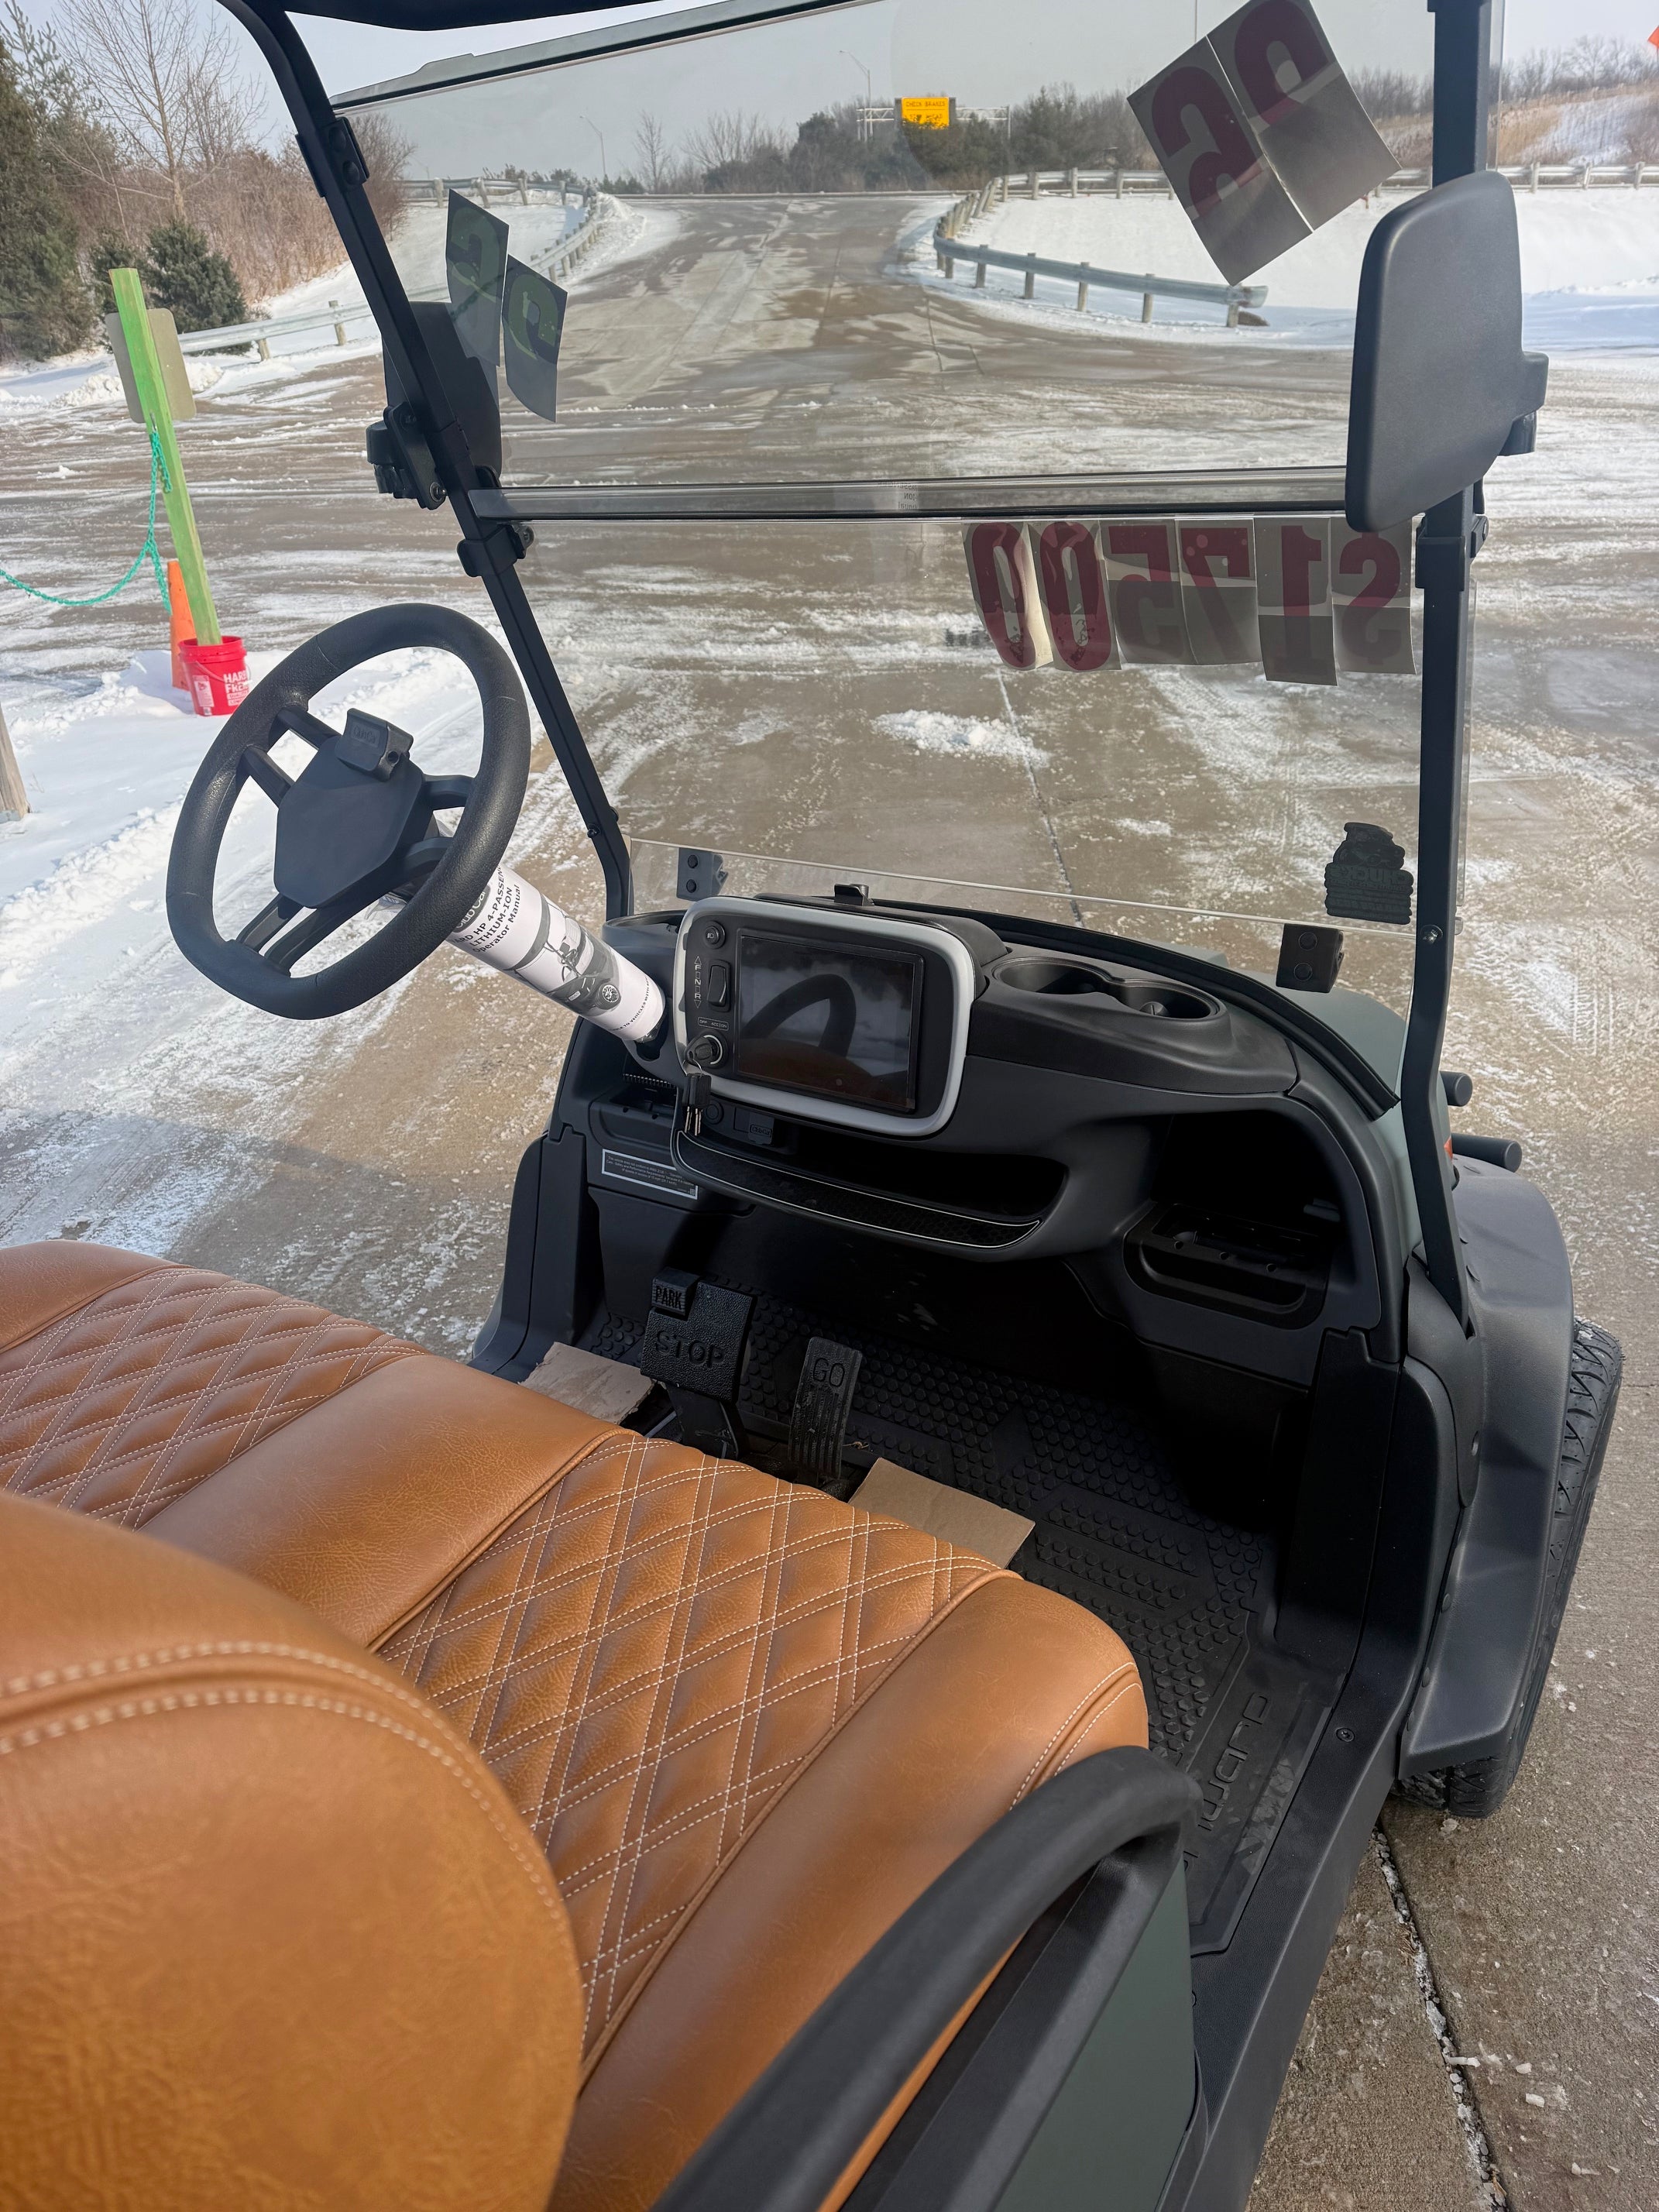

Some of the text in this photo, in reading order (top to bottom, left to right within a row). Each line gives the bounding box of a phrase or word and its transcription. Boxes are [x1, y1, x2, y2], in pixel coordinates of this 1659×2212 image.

[470, 887, 512, 946] LITHIUM-ION
[472, 884, 520, 953] Operator Manual
[473, 922, 486, 935] HP
[655, 1285, 683, 1310] PARK
[655, 1330, 724, 1368] STOP
[813, 1358, 846, 1387] GO
